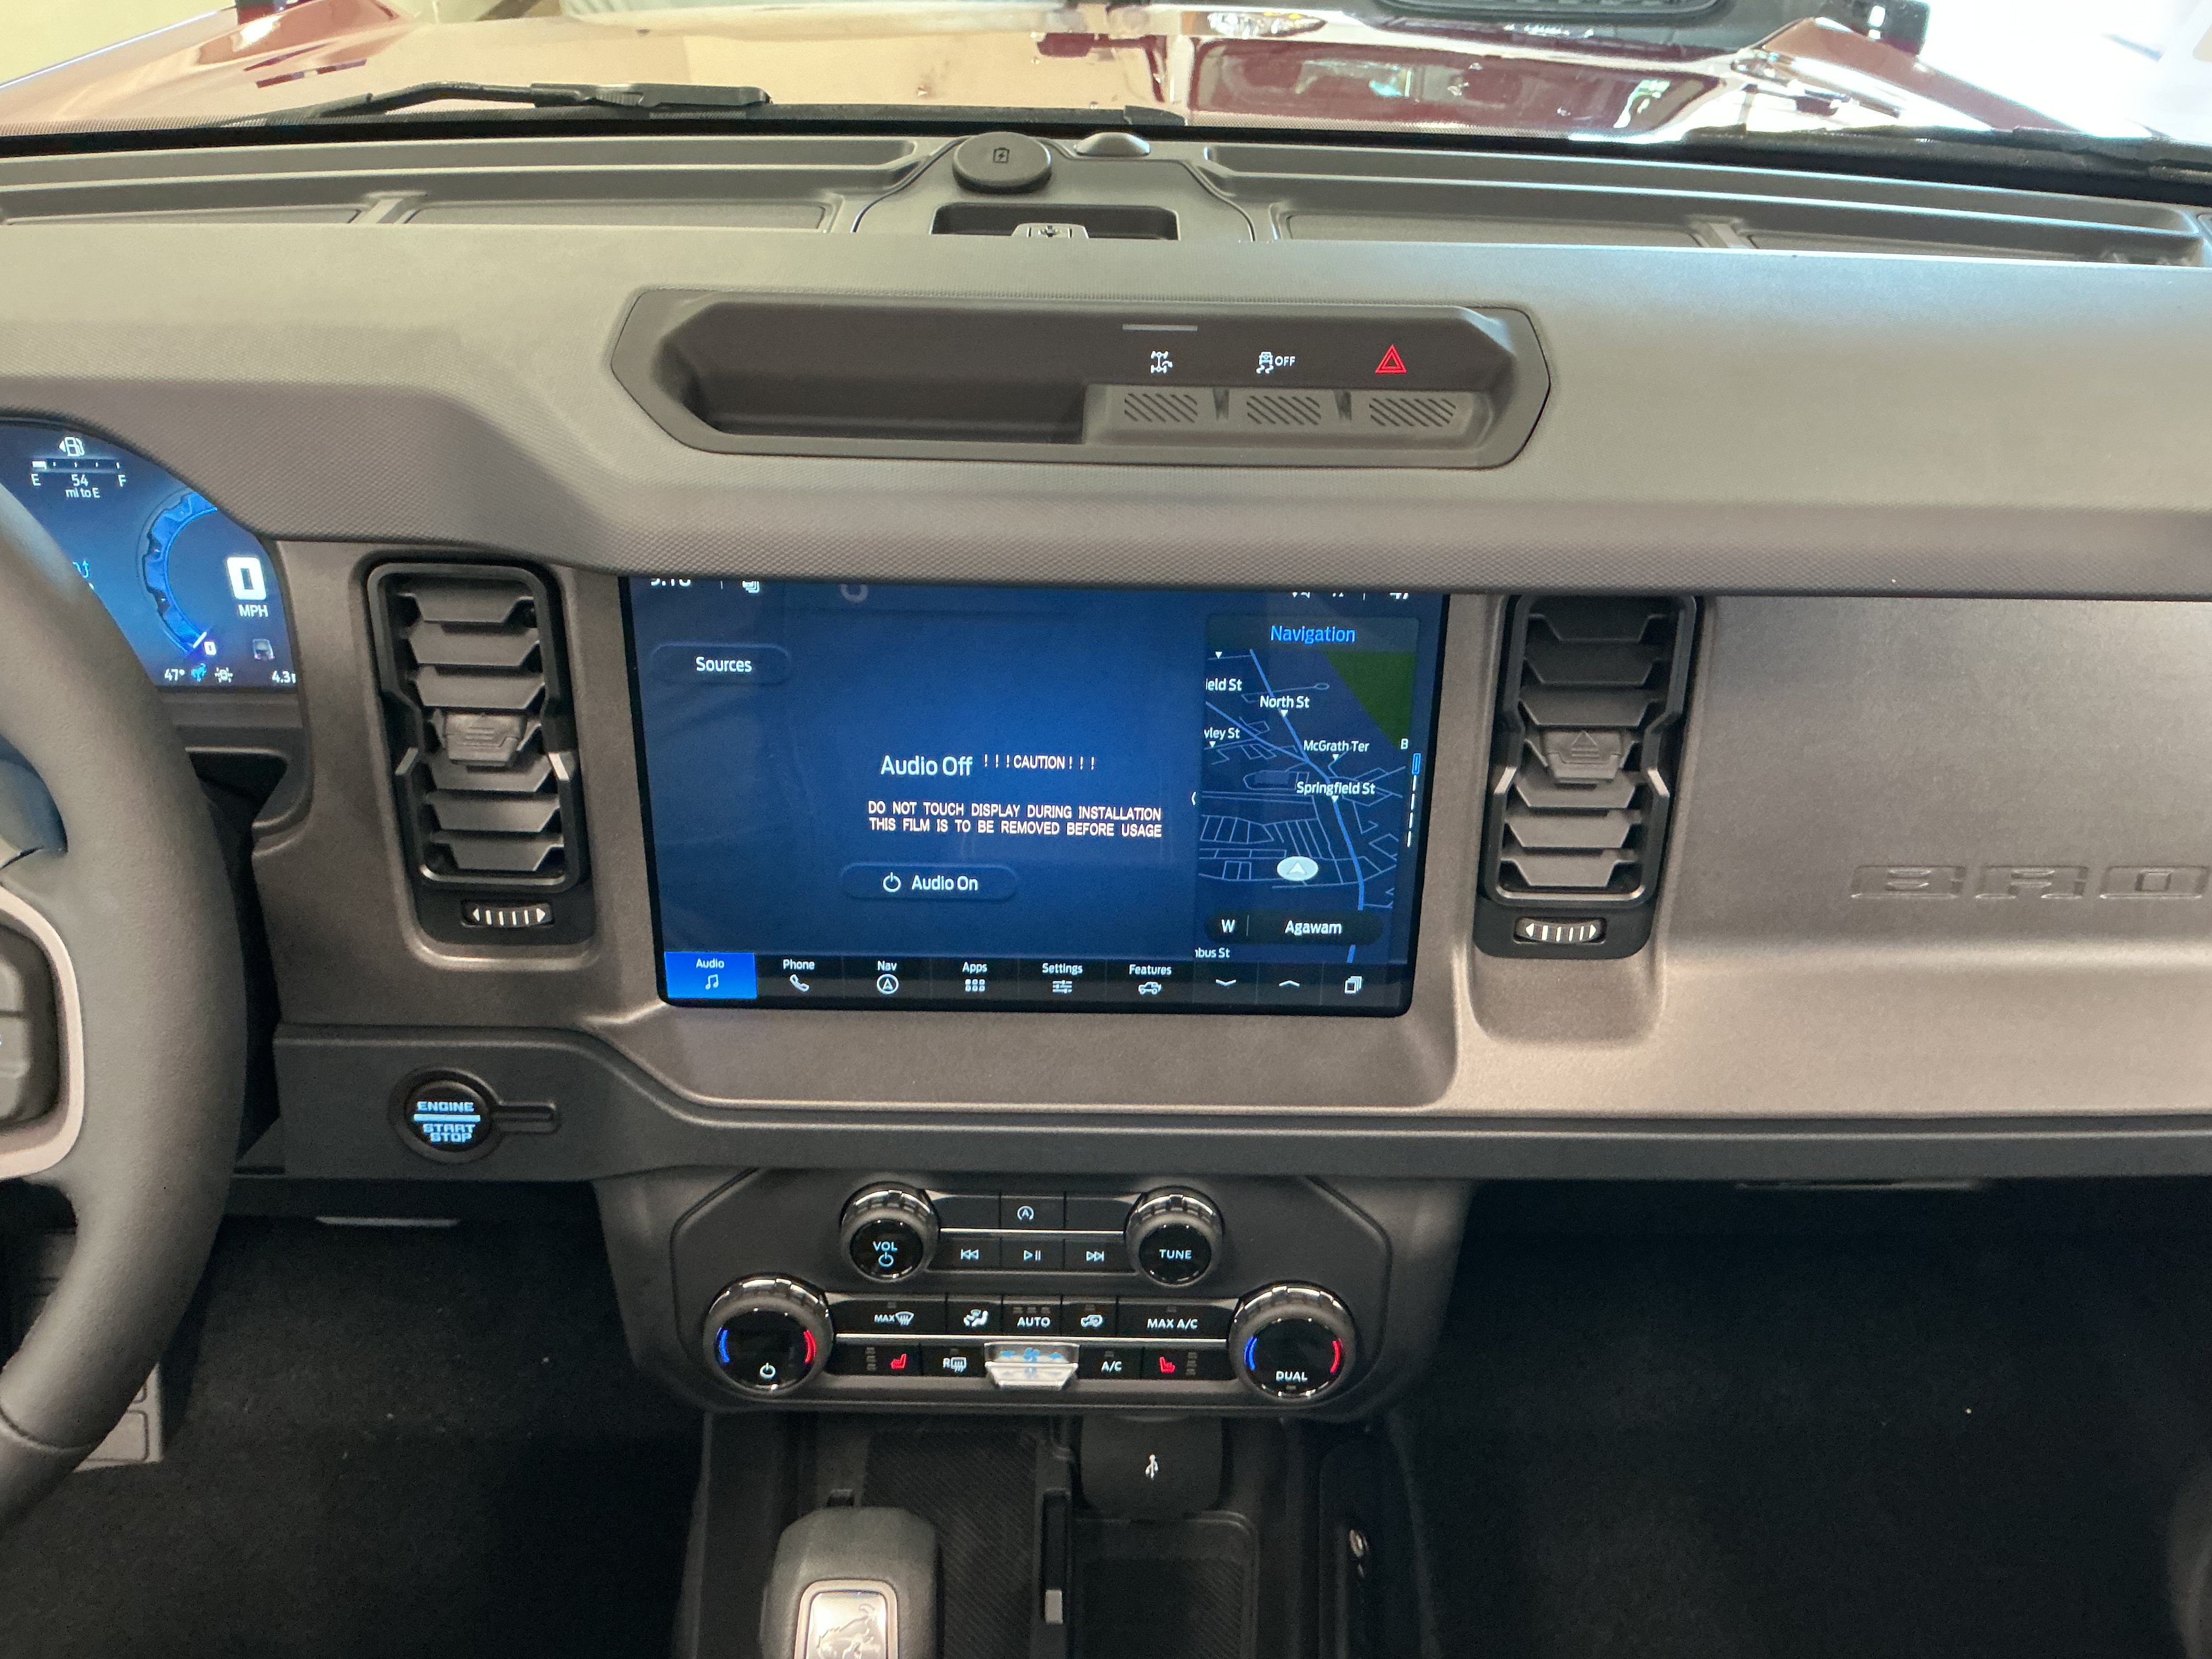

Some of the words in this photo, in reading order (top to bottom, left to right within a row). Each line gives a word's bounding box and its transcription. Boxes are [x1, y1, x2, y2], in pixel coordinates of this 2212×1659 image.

[1274, 356, 1296, 367] OFF
[31, 474, 42, 486] E
[71, 474, 89, 486] 54
[117, 475, 127, 487] F
[65, 488, 79, 498] mi
[80, 488, 91, 498] to
[92, 488, 100, 498] E
[226, 556, 267, 601] 0
[238, 604, 269, 618] MPH
[1271, 625, 1357, 645] Navigation
[696, 656, 752, 673] Sources
[1228, 678, 1243, 692] St
[1260, 695, 1294, 709] North
[1296, 695, 1310, 709] St
[1227, 727, 1241, 739] St
[1303, 740, 1350, 753] McGrath
[1351, 740, 1370, 753] Ter
[1400, 738, 1409, 750] B
[881, 755, 938, 776] Audio
[942, 755, 973, 776] Off
[1296, 781, 1361, 796] Springfield
[1361, 782, 1376, 795] St
[868, 800, 886, 815] DO
[893, 801, 917, 815] NOT
[923, 802, 964, 816] TOUCH
[971, 803, 1020, 817] DISPLAY
[1027, 804, 1072, 819] DURING
[1078, 805, 1162, 821] INSTALLATION
[869, 817, 896, 831] THIS
[902, 818, 930, 832] FILM
[936, 819, 949, 833] IS
[955, 819, 971, 833] TO
[978, 820, 995, 833] BE
[1001, 820, 1060, 836] REMOVED
[1066, 822, 1115, 837] BEFORE
[1121, 823, 1163, 838] USAGE
[911, 874, 955, 891] Audio
[957, 876, 979, 891] On
[1221, 919, 1236, 933] W
[1285, 920, 1342, 936] Agawam
[1218, 947, 1231, 958] St
[696, 958, 725, 969] Audio
[783, 959, 815, 970] Phone
[877, 960, 898, 972] Nav
[962, 961, 988, 974] Apps
[1042, 962, 1083, 976] Settings
[1128, 964, 1172, 976] Features
[416, 1101, 474, 1113] ENGINE
[422, 1123, 476, 1133] START
[430, 1132, 472, 1143] STOP
[872, 1241, 898, 1252] VOL
[1159, 1249, 1192, 1260] TUNE
[874, 1314, 895, 1323] MAX
[1017, 1316, 1051, 1328] AUTO
[1147, 1318, 1175, 1329] MAX
[1177, 1318, 1198, 1330] A/C
[1101, 1361, 1122, 1373] A/C
[1276, 1370, 1308, 1383] DUAL
